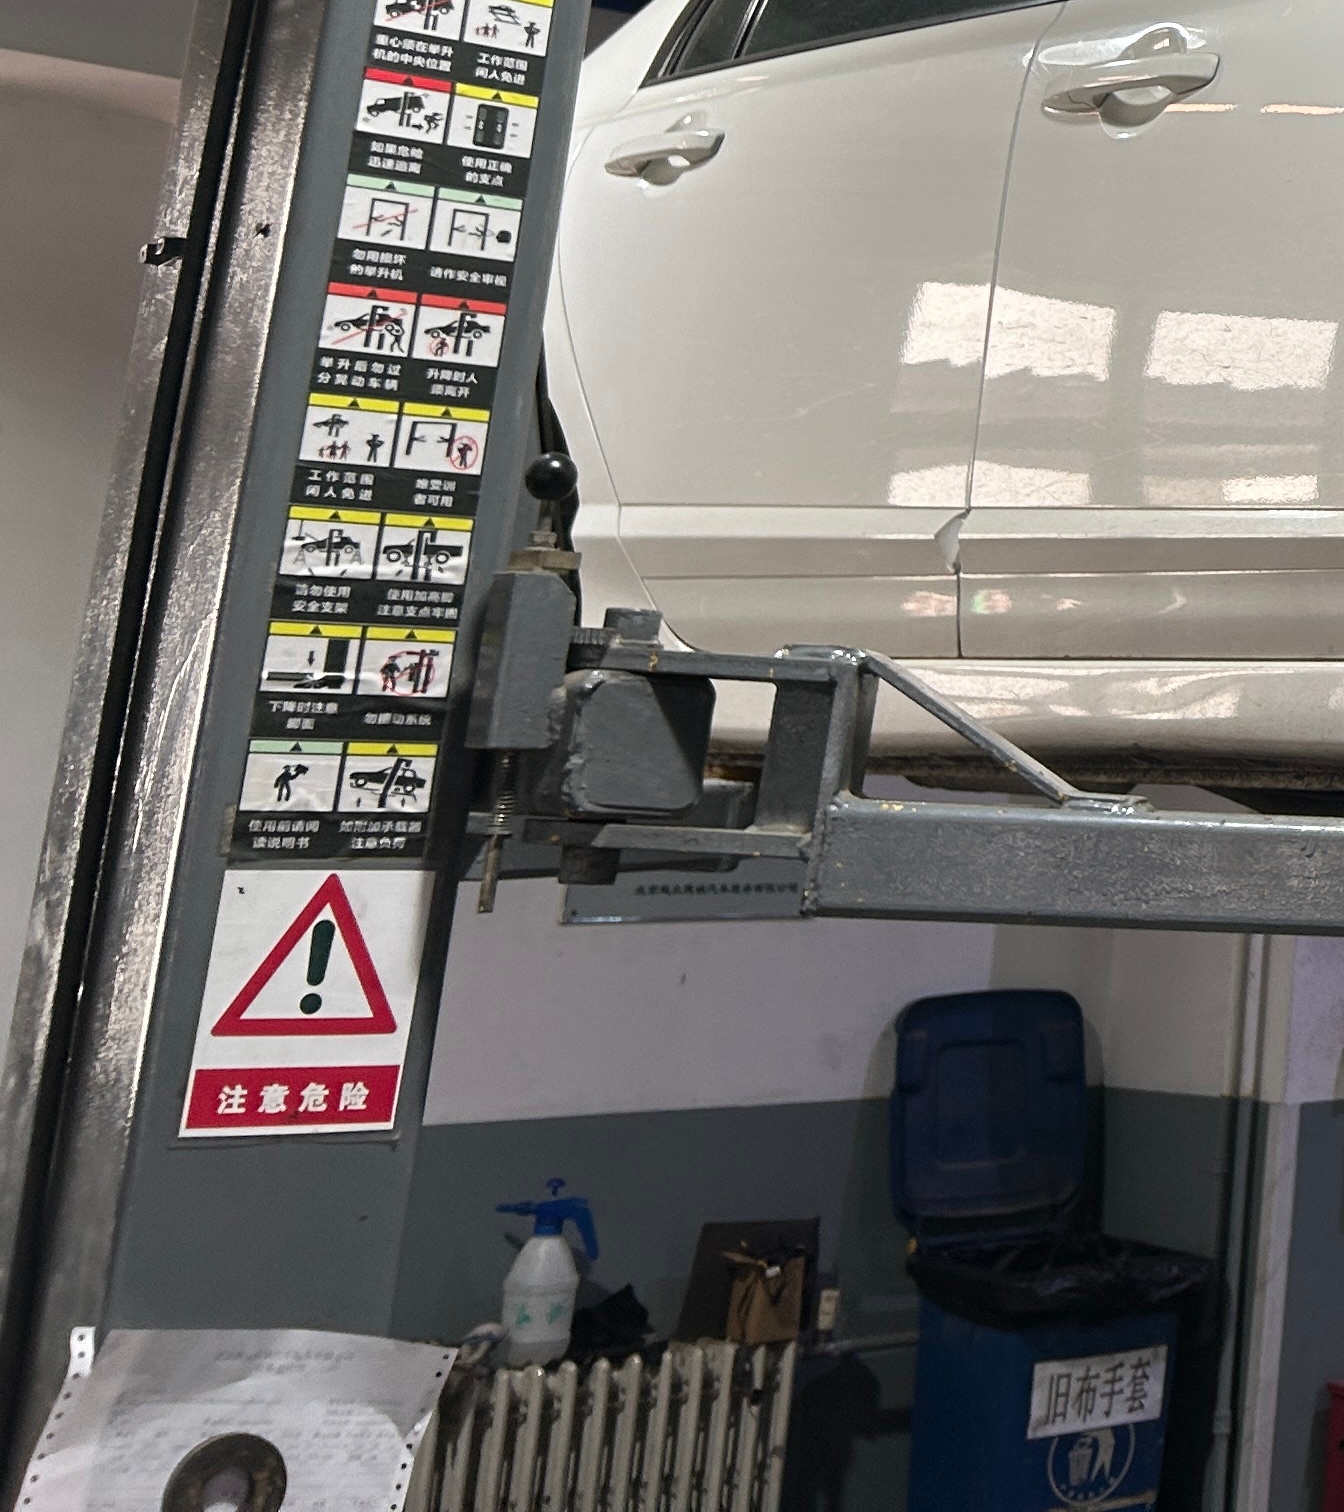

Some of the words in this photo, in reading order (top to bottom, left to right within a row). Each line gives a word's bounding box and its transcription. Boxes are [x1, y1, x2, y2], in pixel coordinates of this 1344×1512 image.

[477, 52, 528, 72] 工作范围
[465, 170, 504, 187] 的支点
[217, 1081, 370, 1114] 注意危险
[1045, 1356, 1151, 1424] 旧布手套
